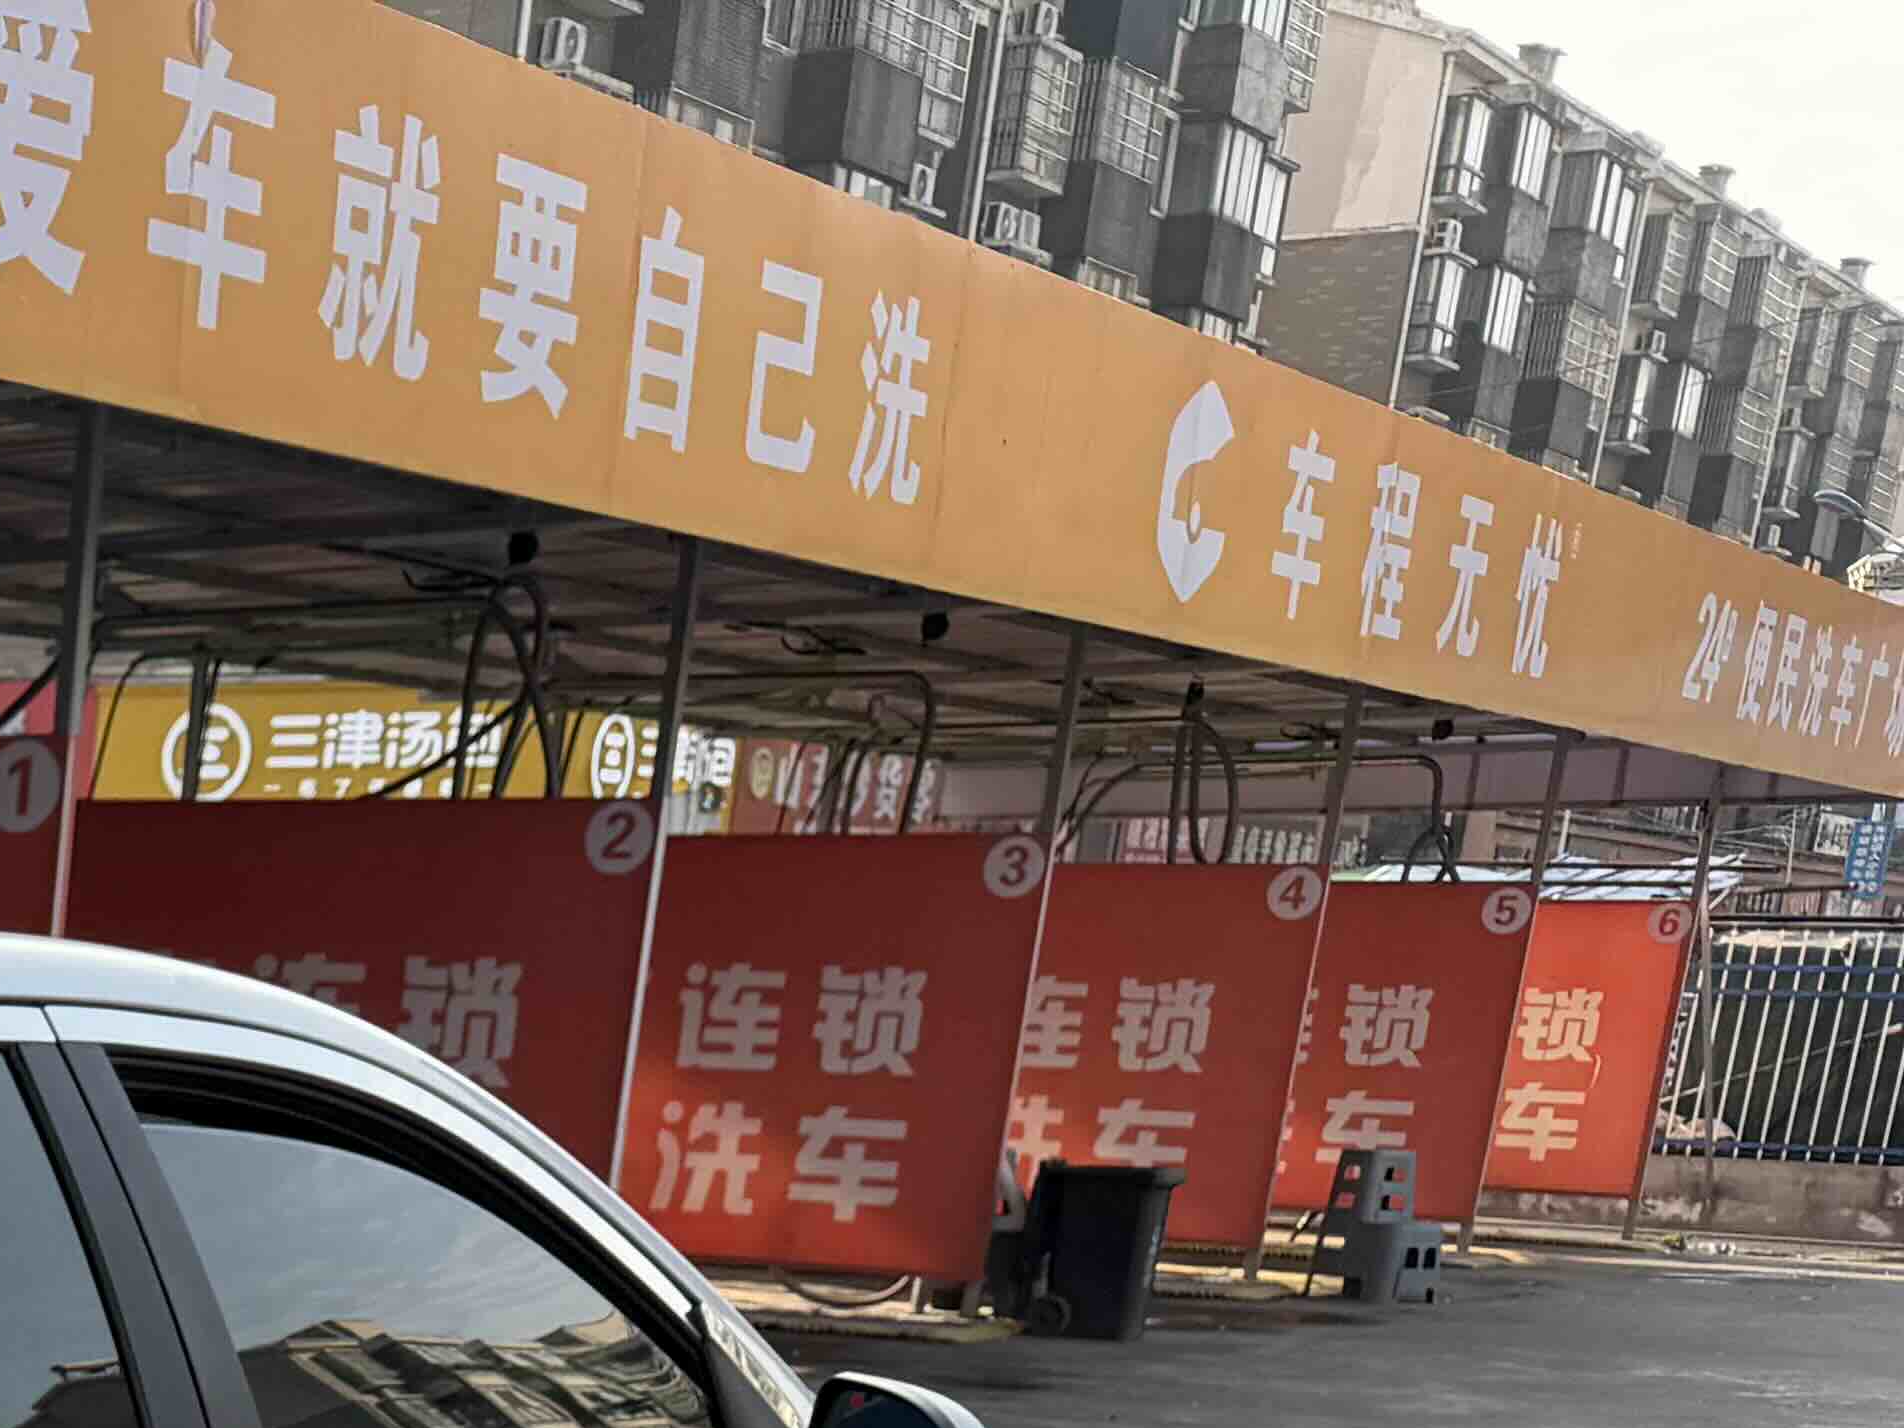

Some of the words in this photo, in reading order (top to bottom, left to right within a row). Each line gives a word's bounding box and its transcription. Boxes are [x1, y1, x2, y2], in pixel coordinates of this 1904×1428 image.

[1271, 428, 1562, 680] 车程无忧
[7, 752, 35, 817] 1
[602, 814, 637, 860] 2
[998, 846, 1029, 887] 3
[1279, 874, 1307, 911] 4
[1494, 895, 1517, 926] 5
[1658, 908, 1681, 936] 6
[677, 962, 928, 1077] 连锁
[1295, 983, 1434, 1069] 锁
[1495, 1082, 1586, 1162] 车
[649, 1101, 908, 1223] 洗车
